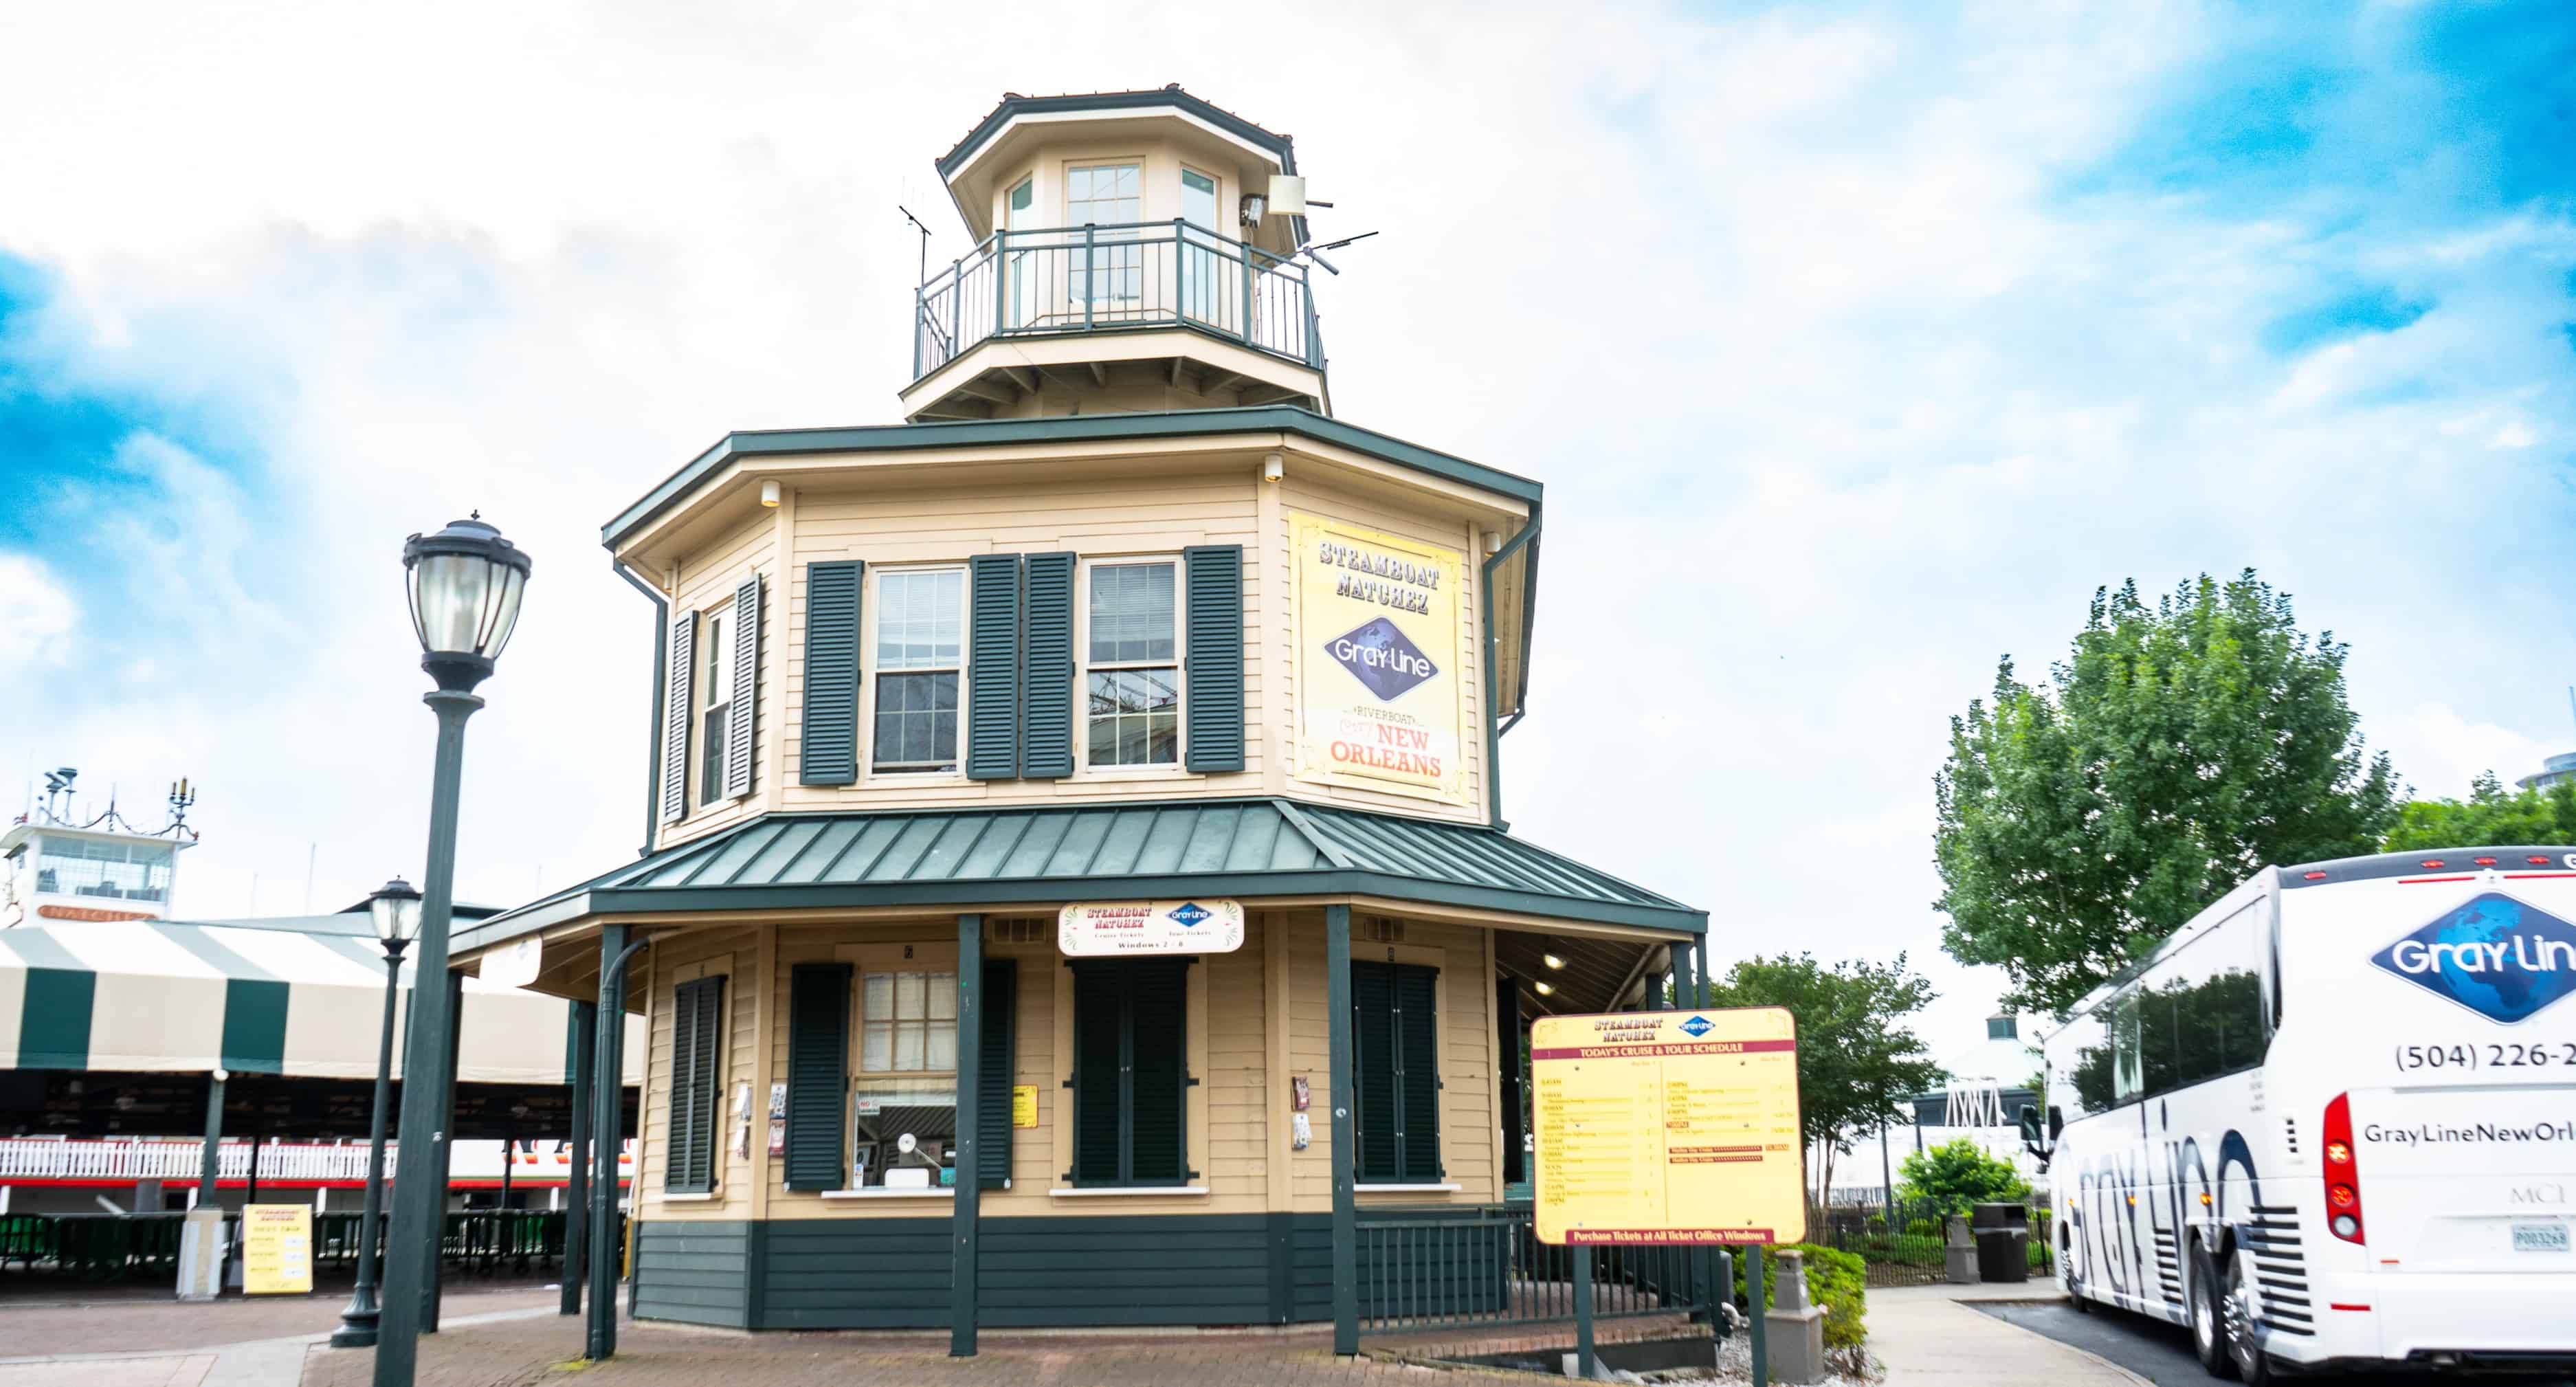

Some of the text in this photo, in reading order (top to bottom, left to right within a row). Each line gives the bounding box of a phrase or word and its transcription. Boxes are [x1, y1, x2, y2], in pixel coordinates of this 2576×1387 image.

[1319, 542, 1440, 590] STEAMBOAT
[1336, 573, 1429, 615] NATCHEZ
[1335, 639, 1430, 678] Gray Line
[1357, 706, 1414, 725] RIVERBOAT
[1377, 723, 1430, 751] NEW
[1331, 740, 1441, 777] ORLEANS
[1087, 907, 1151, 919] STEAMBOAT
[1171, 910, 1193, 920] Gray
[1095, 918, 1144, 929] NATCHEZ
[2392, 940, 2508, 974] Gray
[1594, 1018, 1663, 1031] STEAMBOAT
[1603, 1030, 1656, 1043] NATCHEZ
[1581, 1043, 1744, 1058] TODAY'S CRUISE & TOUR SCHEDULE
[2397, 1043, 2576, 1072] (504) 226-2
[1574, 1230, 1766, 1241] Purchase Tickets at All Ticket Office Windows
